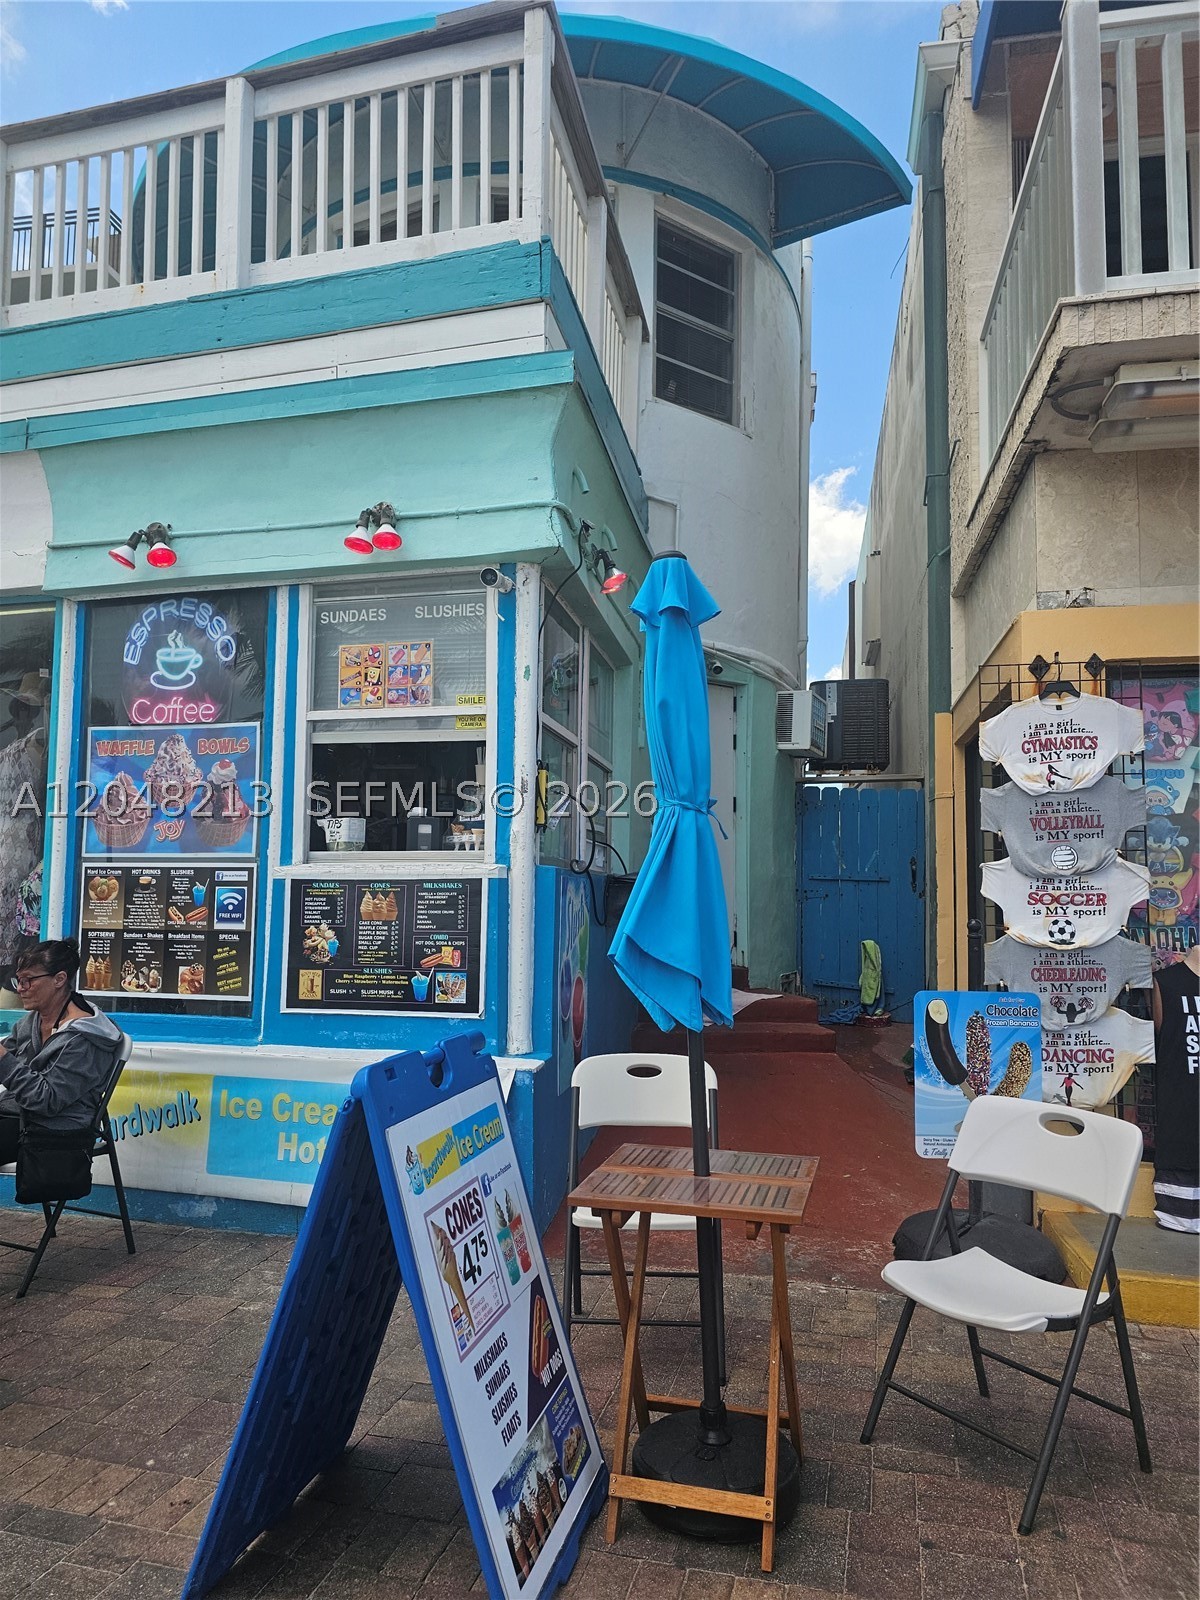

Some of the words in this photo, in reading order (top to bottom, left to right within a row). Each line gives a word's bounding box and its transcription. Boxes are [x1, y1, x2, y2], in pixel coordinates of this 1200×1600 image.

[320, 608, 386, 624] SUNDAES
[414, 603, 484, 618] SLUSHIES
[123, 597, 236, 665] ESPRESSO
[458, 696, 486, 704] SMILE!
[132, 697, 214, 724] Coffee
[1056, 719, 1080, 728] girl...
[1056, 726, 1093, 734] athlete...
[96, 739, 155, 756] WAFFLE
[198, 737, 249, 754] BOWLS
[1021, 736, 1098, 754] GYMNASTICS
[1028, 755, 1036, 763] is
[1040, 751, 1062, 761] MY
[1066, 750, 1096, 761] sport!
[1063, 805, 1100, 813] athlete...
[1064, 797, 1086, 807] girl...
[327, 819, 343, 829] TIPS
[1029, 814, 1104, 831] VOLLEYBALL
[153, 819, 185, 842] JOY
[1035, 832, 1044, 841] is
[1047, 830, 1070, 840] MY
[1073, 829, 1104, 842] sport!
[1065, 876, 1088, 885] girl...
[1027, 891, 1107, 906] SOCCER
[1032, 907, 1041, 915] is
[1046, 906, 1069, 915] MY
[1073, 907, 1106, 918] sport!
[1067, 949, 1090, 960] girl...
[1030, 967, 1106, 982] CHEERLEADING
[1039, 983, 1047, 992] is
[1050, 983, 1073, 992] MY
[1076, 983, 1106, 995] sport!
[986, 1004, 1039, 1017] Chocolate
[1181, 996, 1189, 1013] I
[1073, 1038, 1110, 1046] athlete...
[1075, 1030, 1097, 1040] girl...
[1041, 1048, 1114, 1063] DANCING
[1044, 1063, 1053, 1072] is
[1057, 1063, 1080, 1073] MY
[1083, 1063, 1114, 1076] sport!
[97, 1089, 201, 1143] ardwalk
[219, 1089, 262, 1120] Ice
[272, 1092, 338, 1126] Crea
[276, 1131, 327, 1165] Hot
[422, 1133, 455, 1185] Boardwalk
[455, 1135, 474, 1161] Ice
[473, 1116, 504, 1150] Cream
[923, 1148, 928, 1156] &
[931, 1147, 948, 1158] Totally
[445, 1187, 484, 1240] CONES
[473, 1331, 508, 1382] MILKSHAKES
[540, 1362, 552, 1388] HOT
[549, 1347, 563, 1375] DOGS
[484, 1359, 511, 1400] SUNDAES
[491, 1382, 518, 1426] SLUSHIES
[501, 1410, 522, 1447] FLOATS
